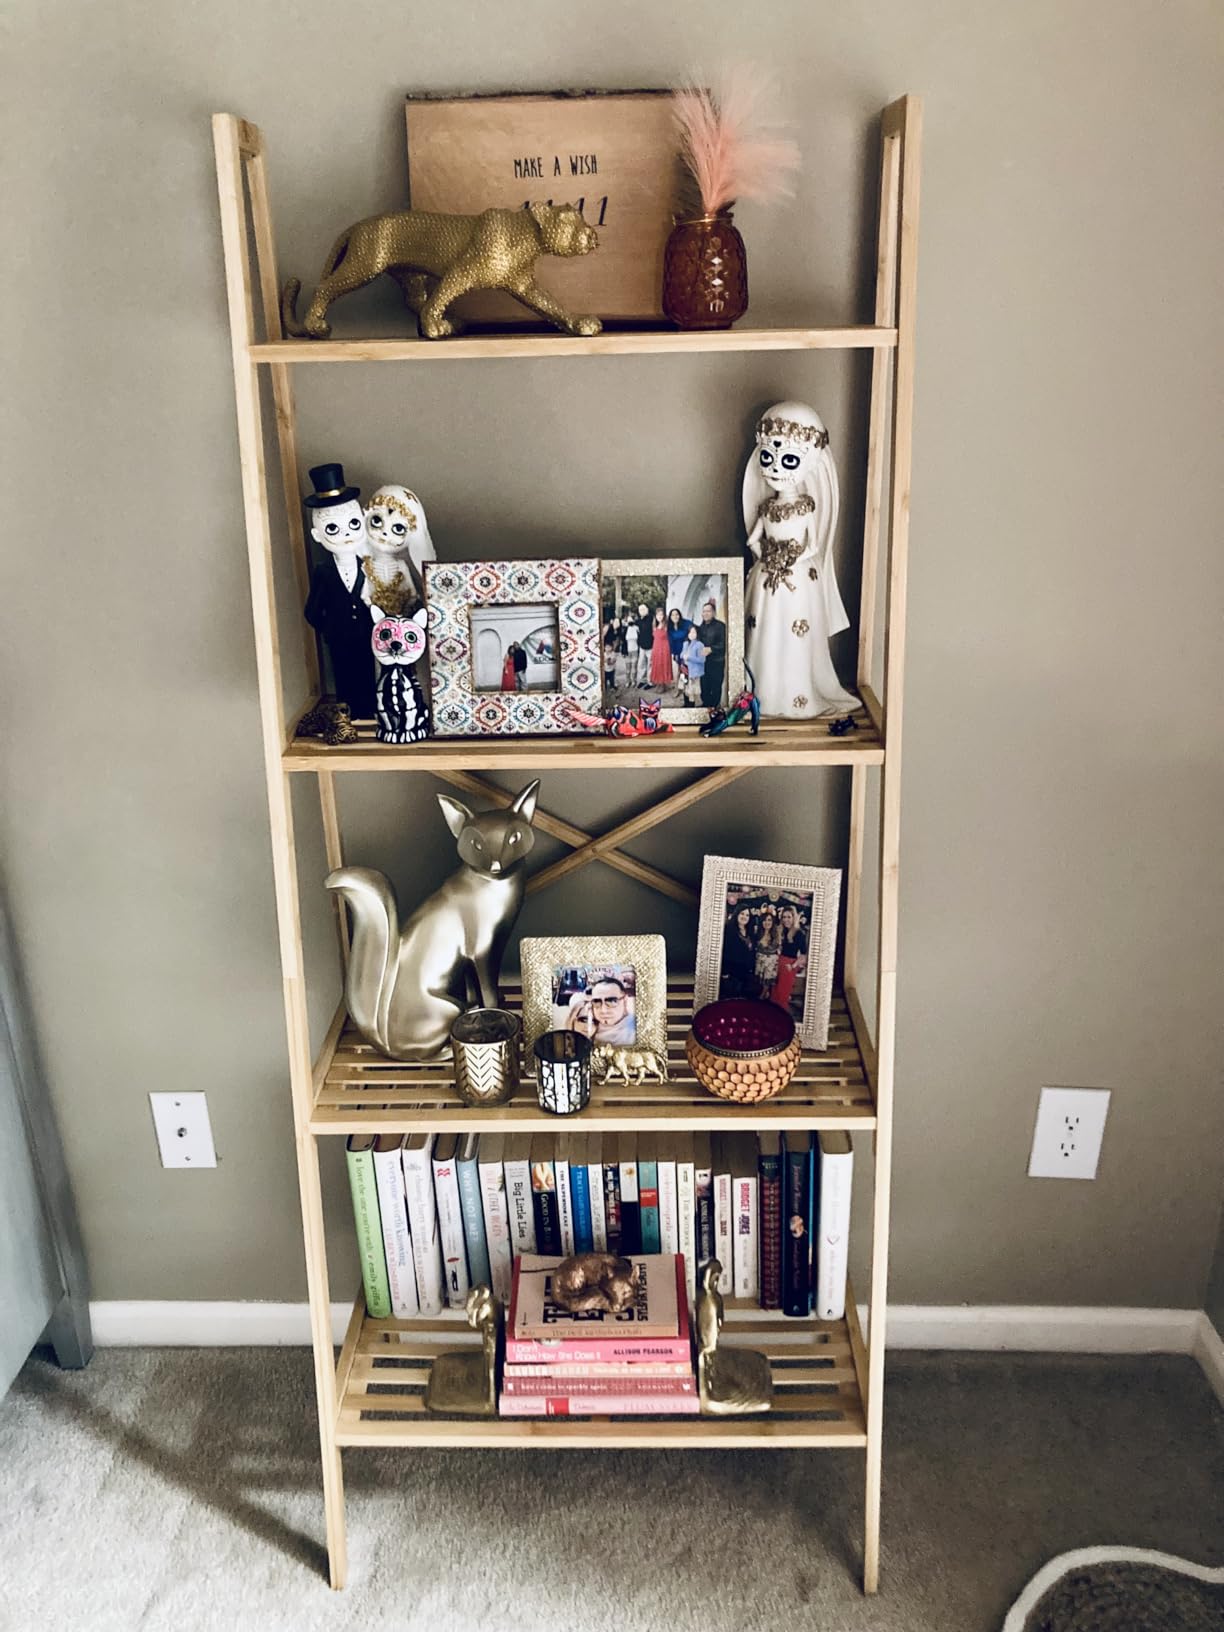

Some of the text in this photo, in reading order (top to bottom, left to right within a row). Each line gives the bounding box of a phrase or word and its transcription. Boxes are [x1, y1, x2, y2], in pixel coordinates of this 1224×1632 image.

[513, 154, 598, 179] MAKE A WISH
[463, 1170, 472, 1192] WHY
[513, 1182, 524, 1196] Big
[740, 1182, 749, 1212] BRIDGET
[386, 1161, 408, 1266] everyone worth knowing
[466, 1198, 475, 1219] NOT
[515, 1198, 525, 1219] Little
[517, 1221, 527, 1239] Lies
[741, 1214, 750, 1235] JONES
[369, 1262, 378, 1282] emily
[509, 1366, 549, 1377] LAUREN
